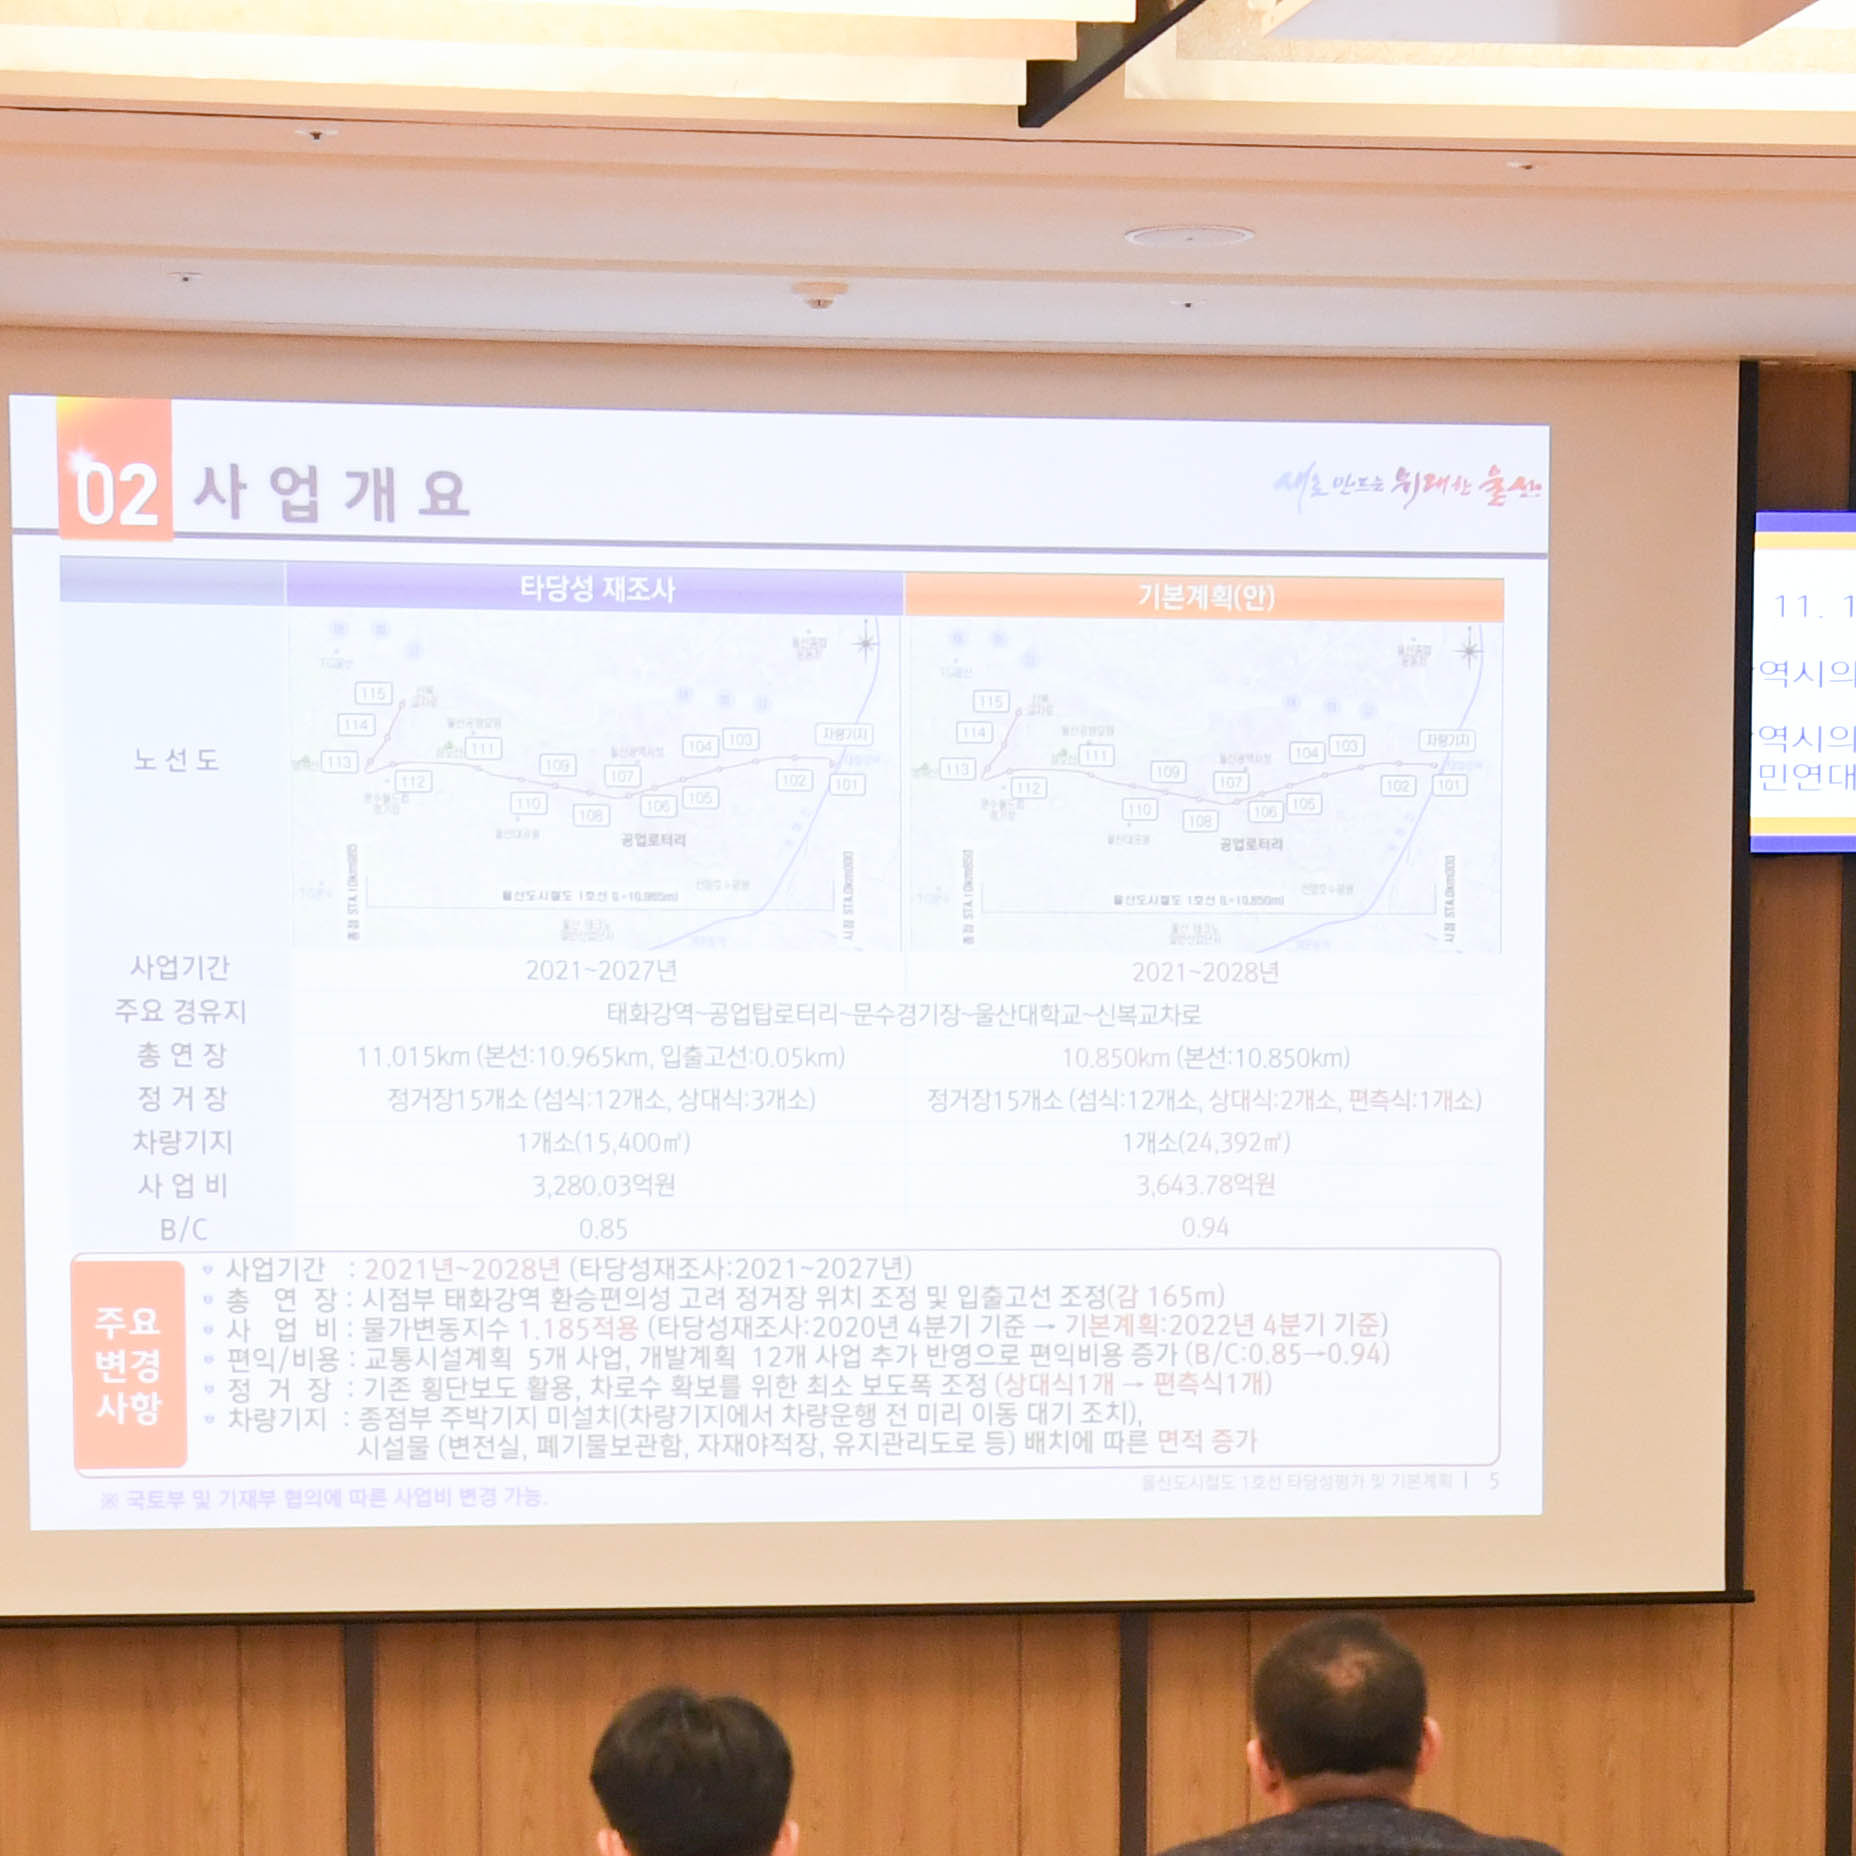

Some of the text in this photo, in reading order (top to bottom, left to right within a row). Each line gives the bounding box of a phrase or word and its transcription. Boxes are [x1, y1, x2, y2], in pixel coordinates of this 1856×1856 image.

[77, 462, 470, 526] 02 사업개요
[521, 576, 676, 603] 타당성 재조사
[1139, 579, 1275, 612] 기본계획(안)
[1776, 595, 1823, 618] 11.
[729, 732, 752, 746] 103
[964, 726, 986, 739] 114
[472, 742, 494, 754] 111
[689, 740, 712, 753] 104
[135, 748, 219, 772] 노선도
[328, 756, 351, 768] 113
[546, 758, 570, 771] 109
[1219, 776, 1242, 788] 107
[1386, 780, 1409, 793] 102
[1438, 779, 1460, 791] 101
[1760, 764, 1856, 791] 민연대
[1128, 803, 1152, 816] 110
[131, 955, 230, 981] 사업기간
[528, 960, 676, 982] 2021~2027년
[1134, 962, 1278, 984] 2021~2028년
[115, 999, 245, 1025] 주요 경유지
[138, 1042, 226, 1068] 총연장
[360, 1045, 844, 1069] 11.015km (본선:10.965km, 입출고선:0.05km)
[1065, 1047, 1349, 1069] 10.850km (본선:10.850km)
[139, 1086, 226, 1112] 정거장
[389, 1088, 815, 1112] 정거장15개소 (섬식:12개소, 상대식:3개소)
[928, 1088, 1481, 1112] 정거장15개소 (섬식:12개소, 상대식:2개소, 편측식:1개소)
[134, 1130, 231, 1156] 차량기지
[520, 1132, 690, 1154] 1개소(15,400㎡)
[1125, 1132, 1290, 1154] 1개소(24,392㎡)
[138, 1173, 226, 1199] 사업비
[534, 1174, 674, 1197] 3,280.03억원
[1139, 1173, 1274, 1196] 3,643.78억원
[161, 1216, 207, 1243] B/C
[580, 1219, 627, 1240] 0.85
[1183, 1217, 1228, 1237] 0.94
[226, 1256, 911, 1282] 사업기간 2021년~2028년 (타당성재조사:2021~2027년)
[227, 1285, 1224, 1314] 총연장 시점부 태화강역 환승편의성 고려 정거장 위치 조정 및 입출고선 조정(감 165m)
[94, 1307, 160, 1341] 주요
[227, 1312, 1387, 1343] 사업비 물가변동지수 1.185적용 (타당성재조사:2020년 4분기 기준 기본계획:2022년 4분기 기준)
[96, 1348, 160, 1384] 변경
[228, 1347, 339, 1373] 편익/비용
[365, 1346, 510, 1372] 교통시설계획
[529, 1347, 565, 1370] 5개
[576, 1346, 630, 1371] 사업,
[640, 1345, 734, 1370] 개발계획
[754, 1345, 805, 1368] 12개
[816, 1344, 860, 1368] 사업
[872, 1344, 917, 1368] 추가
[927, 1344, 1020, 1368] 반영으로
[1030, 1343, 1123, 1368] 편익비용
[1132, 1343, 1178, 1367] 증가
[229, 1372, 1271, 1403] 정거장 기존 횡단보도 활용, 차로수 확보를 위한 최소 보도폭 조정 (상대식1개 편측식1개)
[96, 1392, 163, 1426] 사항
[229, 1401, 1141, 1433] 차량기지 종점부 주박기지 미설치(차량기지에서 차량운행 전 미리 이동 대기 조치),
[358, 1430, 1256, 1460] 시설물 (변전실, 폐기물보관함, 자재야적장, 유지관리도로 등) 배치에 따른 면적 증가
[1490, 1472, 1499, 1490] 5
[128, 1491, 184, 1510] 국토부
[193, 1490, 210, 1509] 및
[220, 1489, 276, 1509] 기재부
[349, 1488, 387, 1508] 따른
[395, 1488, 451, 1508] 사업비
[460, 1488, 496, 1508] 변경
